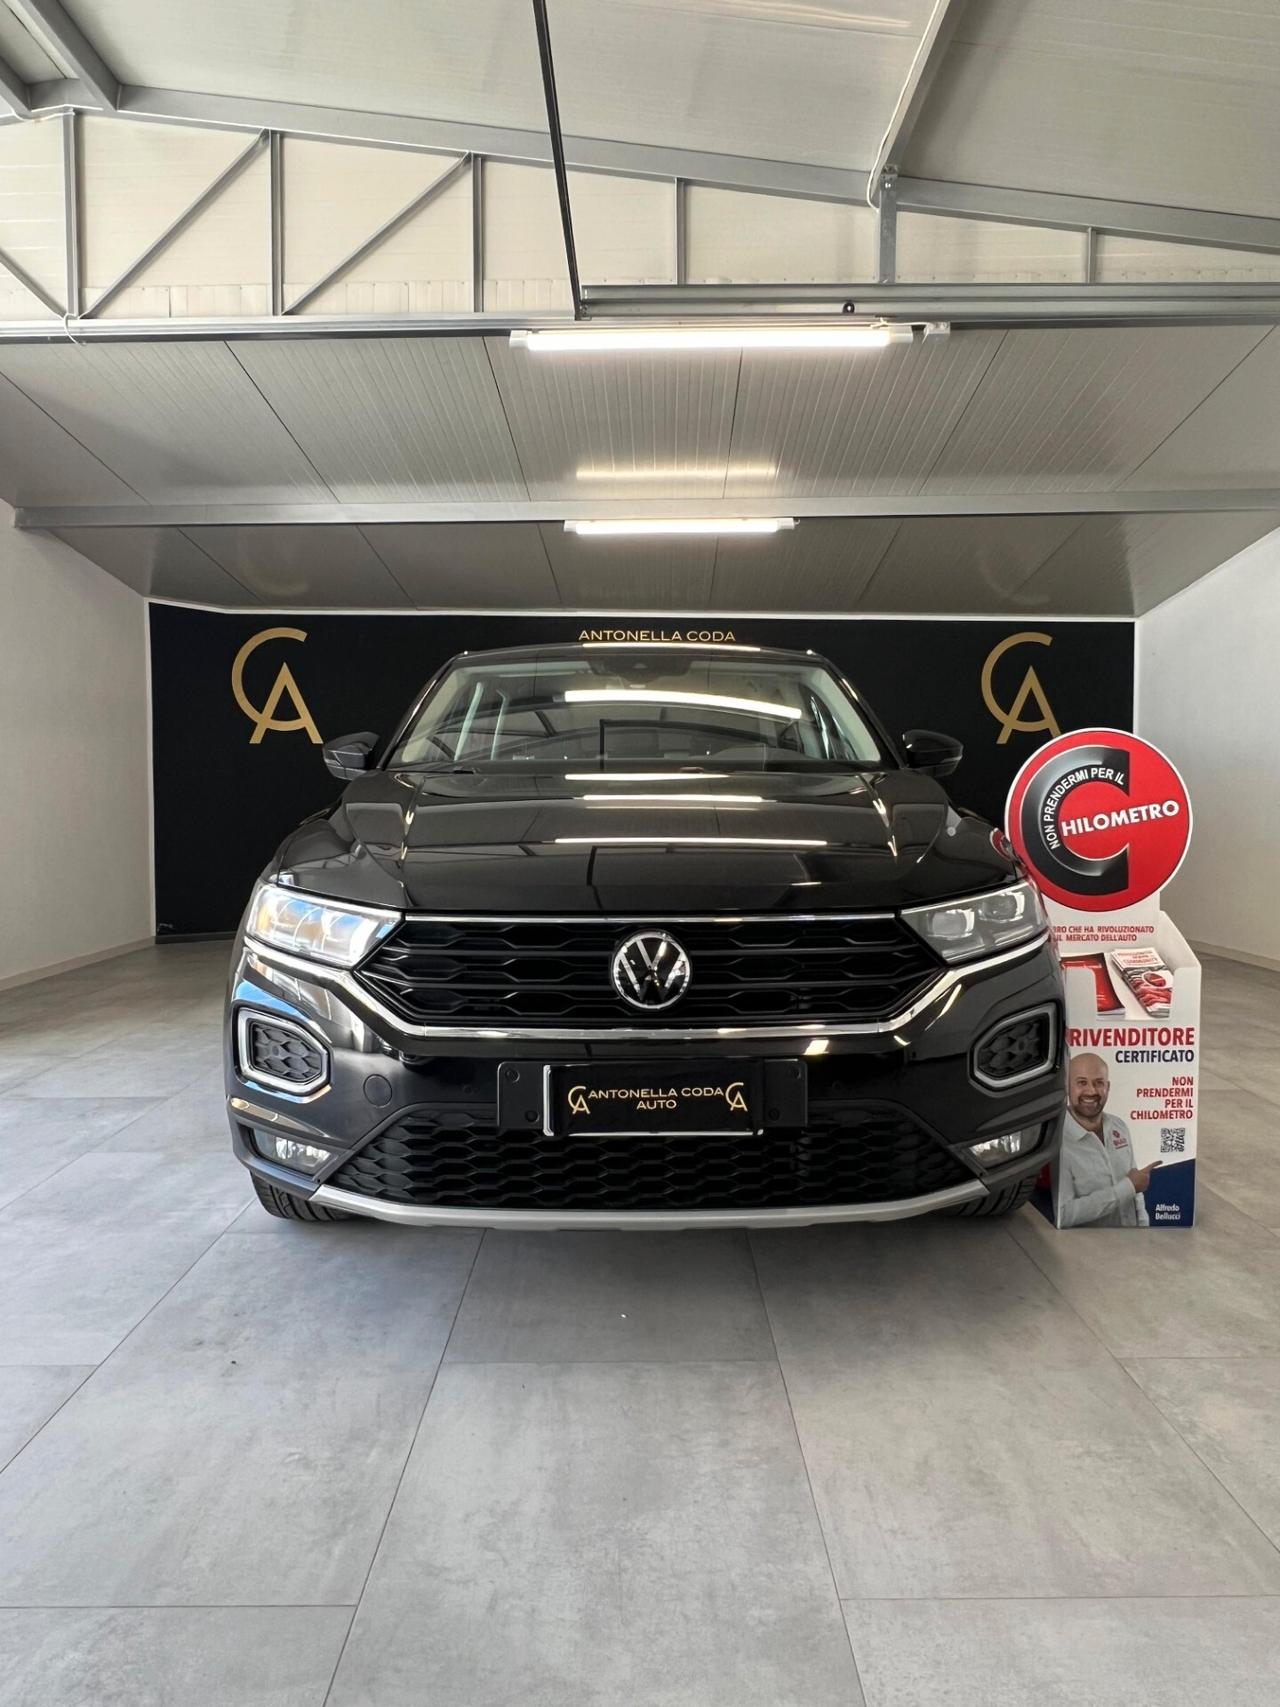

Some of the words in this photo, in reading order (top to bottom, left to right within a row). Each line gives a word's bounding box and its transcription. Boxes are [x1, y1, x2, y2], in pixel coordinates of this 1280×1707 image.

[578, 630, 682, 641] ANTONELLA
[686, 631, 736, 642] CODA
[1091, 767, 1113, 780] PER
[1115, 771, 1125, 785] IL
[1043, 768, 1089, 822] PRENDERMI
[1043, 825, 1060, 850] NON
[1068, 926, 1082, 934] CHE
[1101, 934, 1137, 942] DELL'AUTO
[1069, 1027, 1195, 1047] RIVENDITORE
[1115, 1050, 1194, 1063] CERTIFICATO
[1172, 1076, 1194, 1086] NON
[588, 1088, 678, 1099] ANTONELLA
[681, 1087, 724, 1097] CODA
[1136, 1087, 1193, 1097] PRENDERMI
[636, 1100, 677, 1110] AUTO
[1164, 1099, 1183, 1108] PER
[1185, 1098, 1193, 1108] IL
[1130, 1110, 1193, 1120] CHILOMETRO
[1155, 1203, 1180, 1212] Alfredo
[1155, 1212, 1181, 1220] Bellucci
